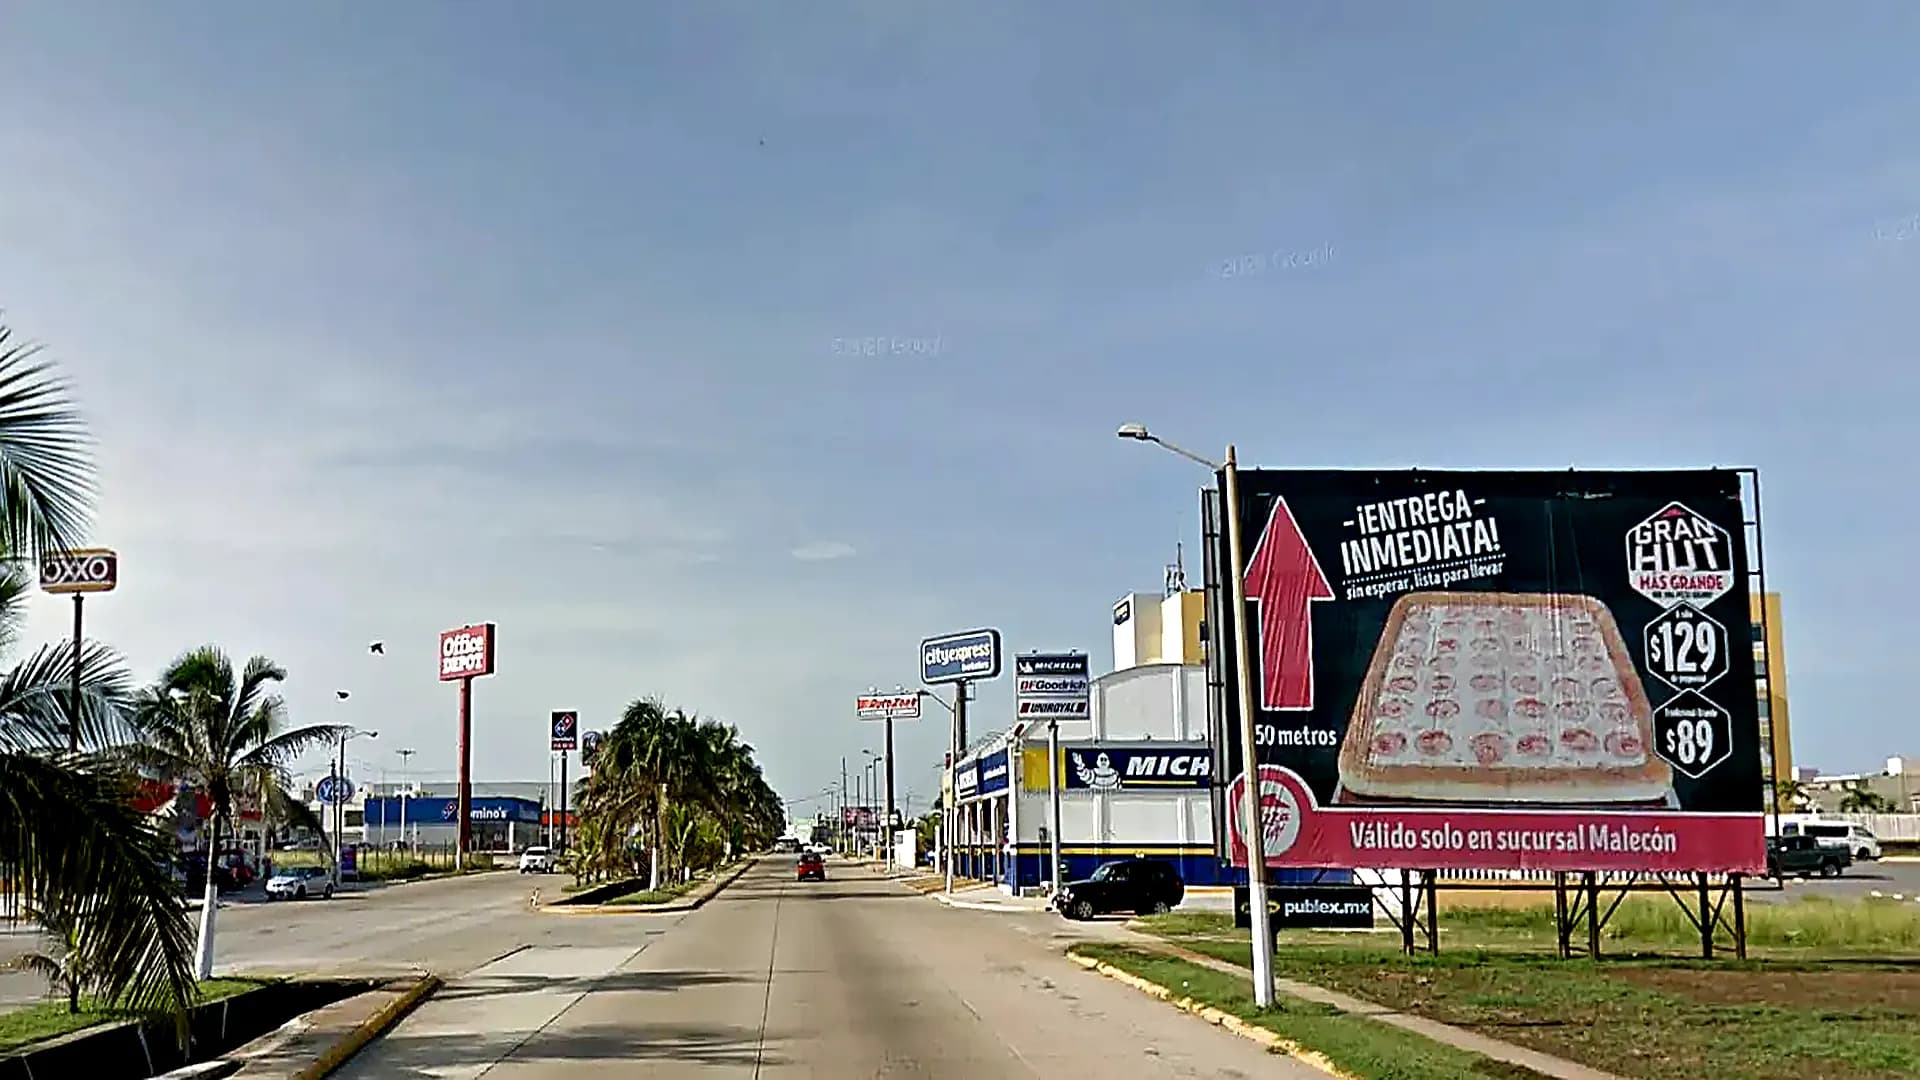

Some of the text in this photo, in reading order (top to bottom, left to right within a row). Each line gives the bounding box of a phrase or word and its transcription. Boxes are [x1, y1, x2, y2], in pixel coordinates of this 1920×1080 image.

[1635, 517, 1716, 545] GRAN
[1340, 517, 1501, 576] INMEDIATA!
[1635, 538, 1719, 571] HUT
[42, 555, 109, 584] OXXO
[1346, 560, 1504, 601] sin esperar, lista para llevar
[1670, 575, 1723, 590] GRANDE
[443, 633, 484, 657] Office
[1650, 621, 1716, 672] $129
[442, 652, 484, 674] DEPOT
[1030, 702, 1076, 713] UNIROYAL
[1255, 724, 1337, 746] 50 metros
[1666, 719, 1713, 765] $89
[1126, 756, 1216, 776] MICH
[470, 805, 507, 820] mino's
[1350, 821, 1677, 853] Válido solo en sucursal Malecón
[1284, 899, 1369, 917] publex.mx
